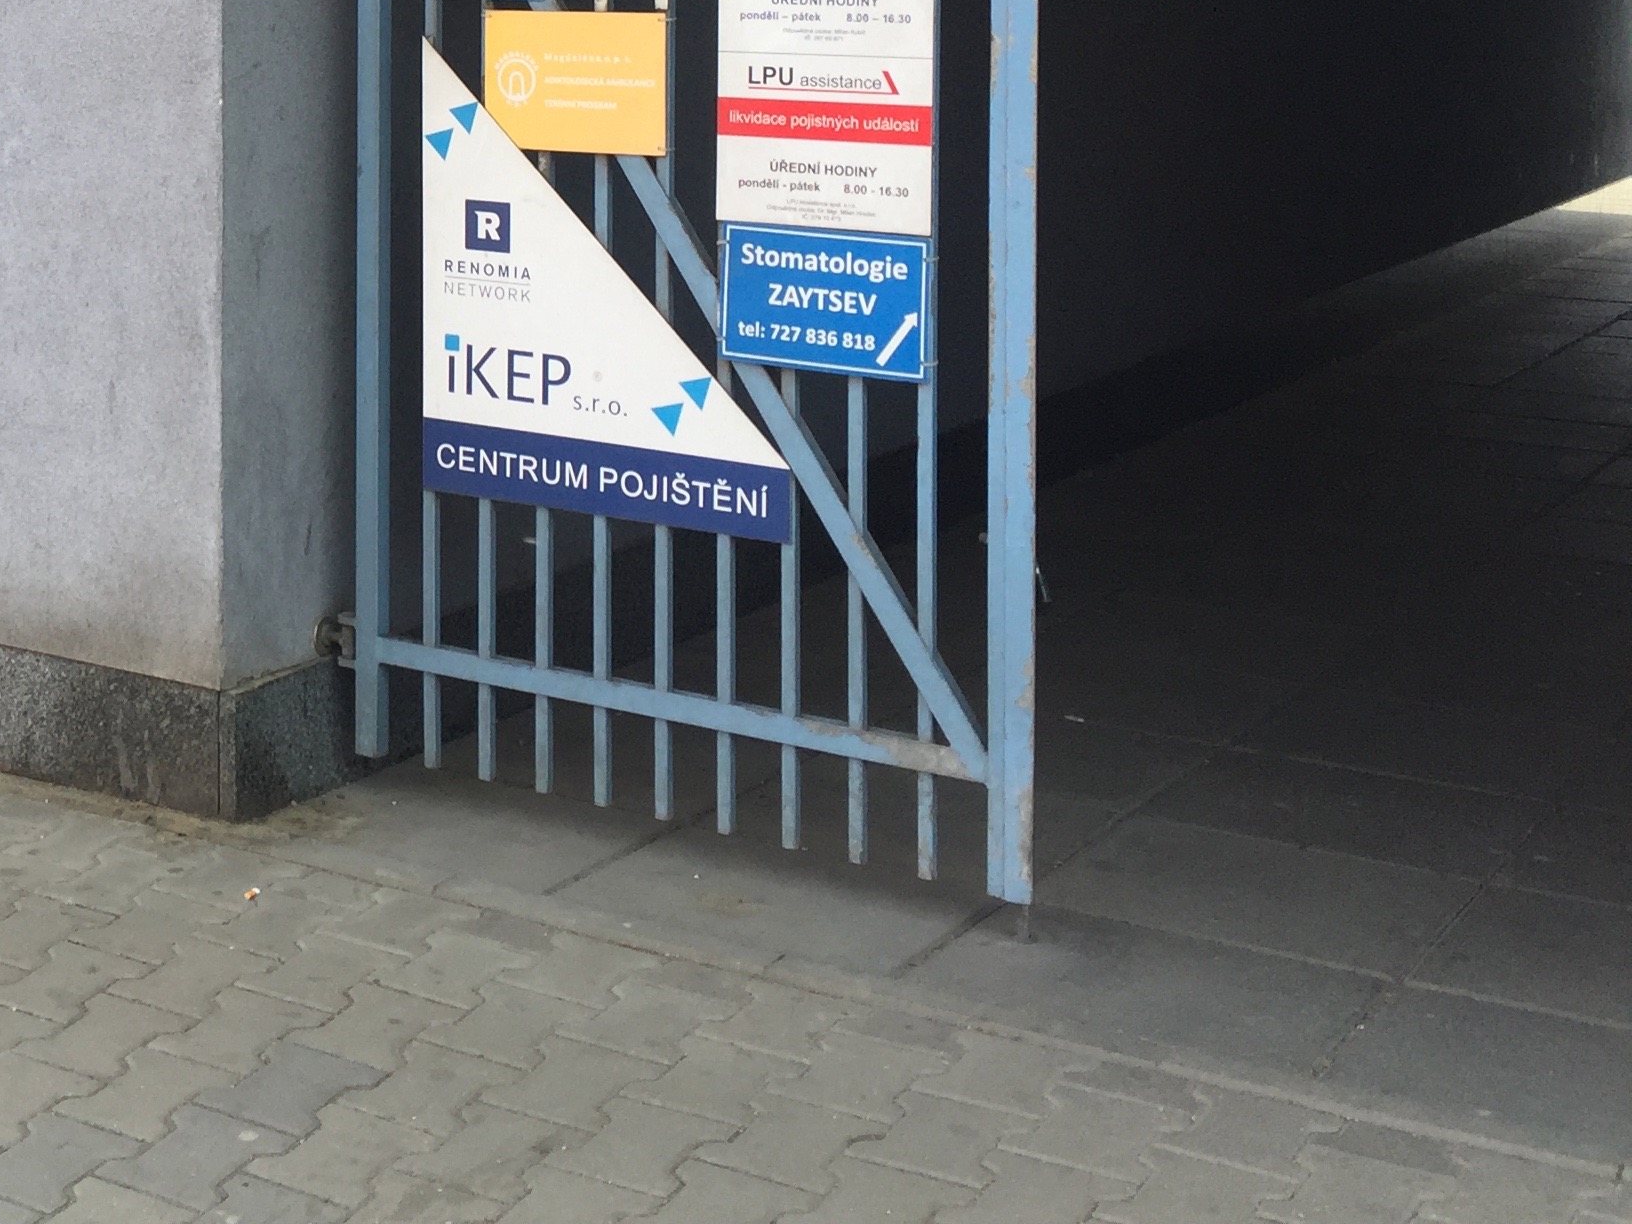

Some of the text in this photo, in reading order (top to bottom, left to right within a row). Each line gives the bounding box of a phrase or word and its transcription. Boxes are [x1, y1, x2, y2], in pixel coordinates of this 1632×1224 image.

[740, 12, 911, 24] pondělí pátek 8.00 16.30
[748, 66, 882, 90] LPU assistance
[729, 110, 919, 132] likvidace pojistných událostí
[770, 159, 878, 177] ÚŘEDNÍ HODINY
[739, 178, 909, 198] pondělí pátek 8.00 16.30
[444, 259, 531, 281] RENOMIA
[740, 242, 908, 283] Stomatologie
[444, 281, 531, 303] NETWORK
[768, 282, 877, 316] ZAYTSEV
[737, 321, 876, 351] tel: 727 836 818
[445, 334, 629, 417] iKEP s.r.o.
[436, 443, 767, 518] CENTRUM POJIŠTĚNÍ
